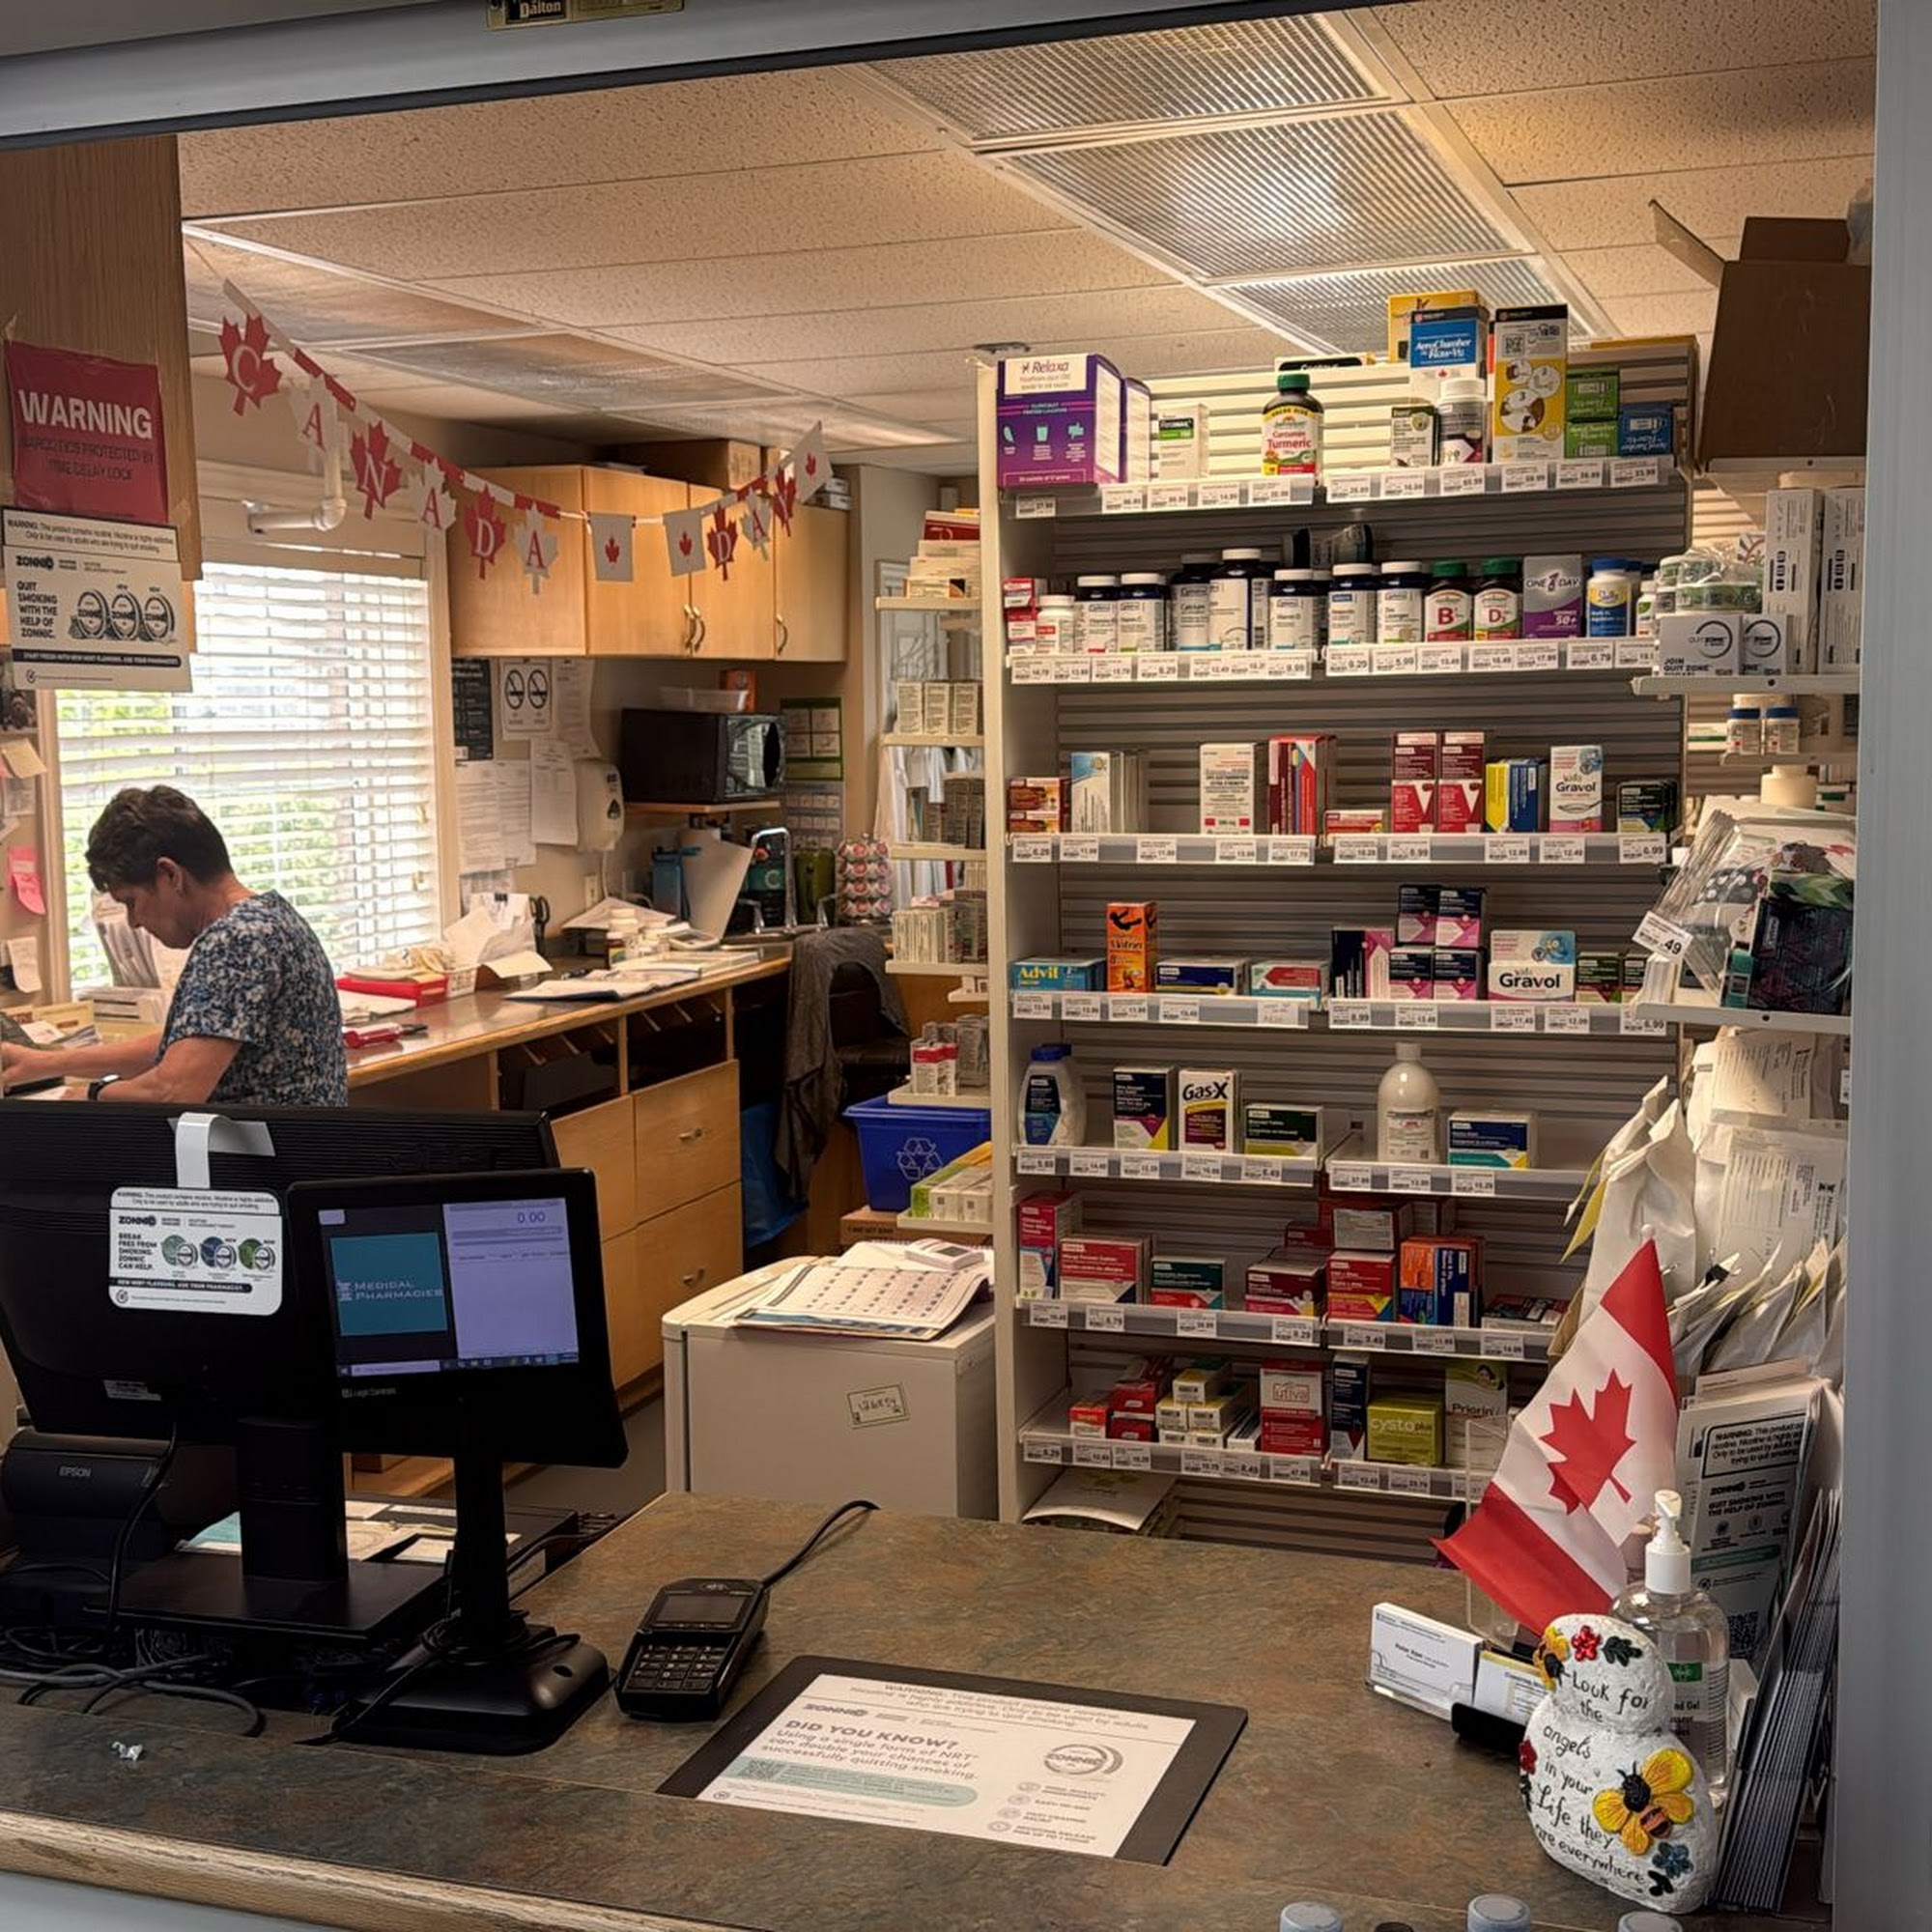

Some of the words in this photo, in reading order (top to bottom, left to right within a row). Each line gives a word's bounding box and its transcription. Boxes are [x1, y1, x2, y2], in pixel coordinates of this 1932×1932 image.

[520, 1, 561, 18] Dalton
[1032, 362, 1069, 374] Relaxa
[18, 389, 153, 439] WARNING
[1267, 438, 1312, 449] Turmeric
[16, 582, 37, 592] QUIT
[1525, 580, 1547, 588] ONE
[1558, 579, 1578, 587] DAY
[18, 593, 58, 605] SMOKING
[19, 605, 41, 616] WITH
[43, 607, 58, 616] THE
[20, 616, 42, 626] HELP
[43, 617, 54, 626] OF
[1556, 781, 1597, 794] Gravol
[1019, 967, 1059, 980] Advil
[1499, 973, 1561, 988] Gravol
[1182, 1081, 1229, 1101] Gas-X
[517, 1211, 546, 1224] 0.00
[355, 1281, 415, 1292] MEDICAL
[355, 1289, 443, 1300] PHARMACIES
[1452, 1403, 1494, 1416] Priorin
[59, 1466, 92, 1477] EPSON
[1573, 1670, 1609, 1701] Look
[1617, 1688, 1650, 1716] for
[1580, 1700, 1604, 1722] the
[785, 1719, 821, 1731] DID
[829, 1724, 875, 1738] YOU
[876, 1730, 959, 1748] KNOW?
[777, 1729, 817, 1743] Using
[833, 1738, 877, 1750] single
[880, 1743, 917, 1754] form
[921, 1747, 934, 1756] of
[1543, 1725, 1592, 1759] angels
[761, 1745, 849, 1763] successfully
[849, 1755, 909, 1771] quitting
[911, 1764, 980, 1780] smoking.
[799, 1741, 849, 1754] double
[852, 1748, 884, 1760] your
[888, 1751, 954, 1768] chances
[957, 1761, 972, 1770] of
[1546, 1756, 1557, 1776] in
[1561, 1771, 1594, 1795] your
[1537, 1785, 1572, 1828] Life
[1579, 1816, 1614, 1850] they
[1558, 1838, 1644, 1883] everywhere
